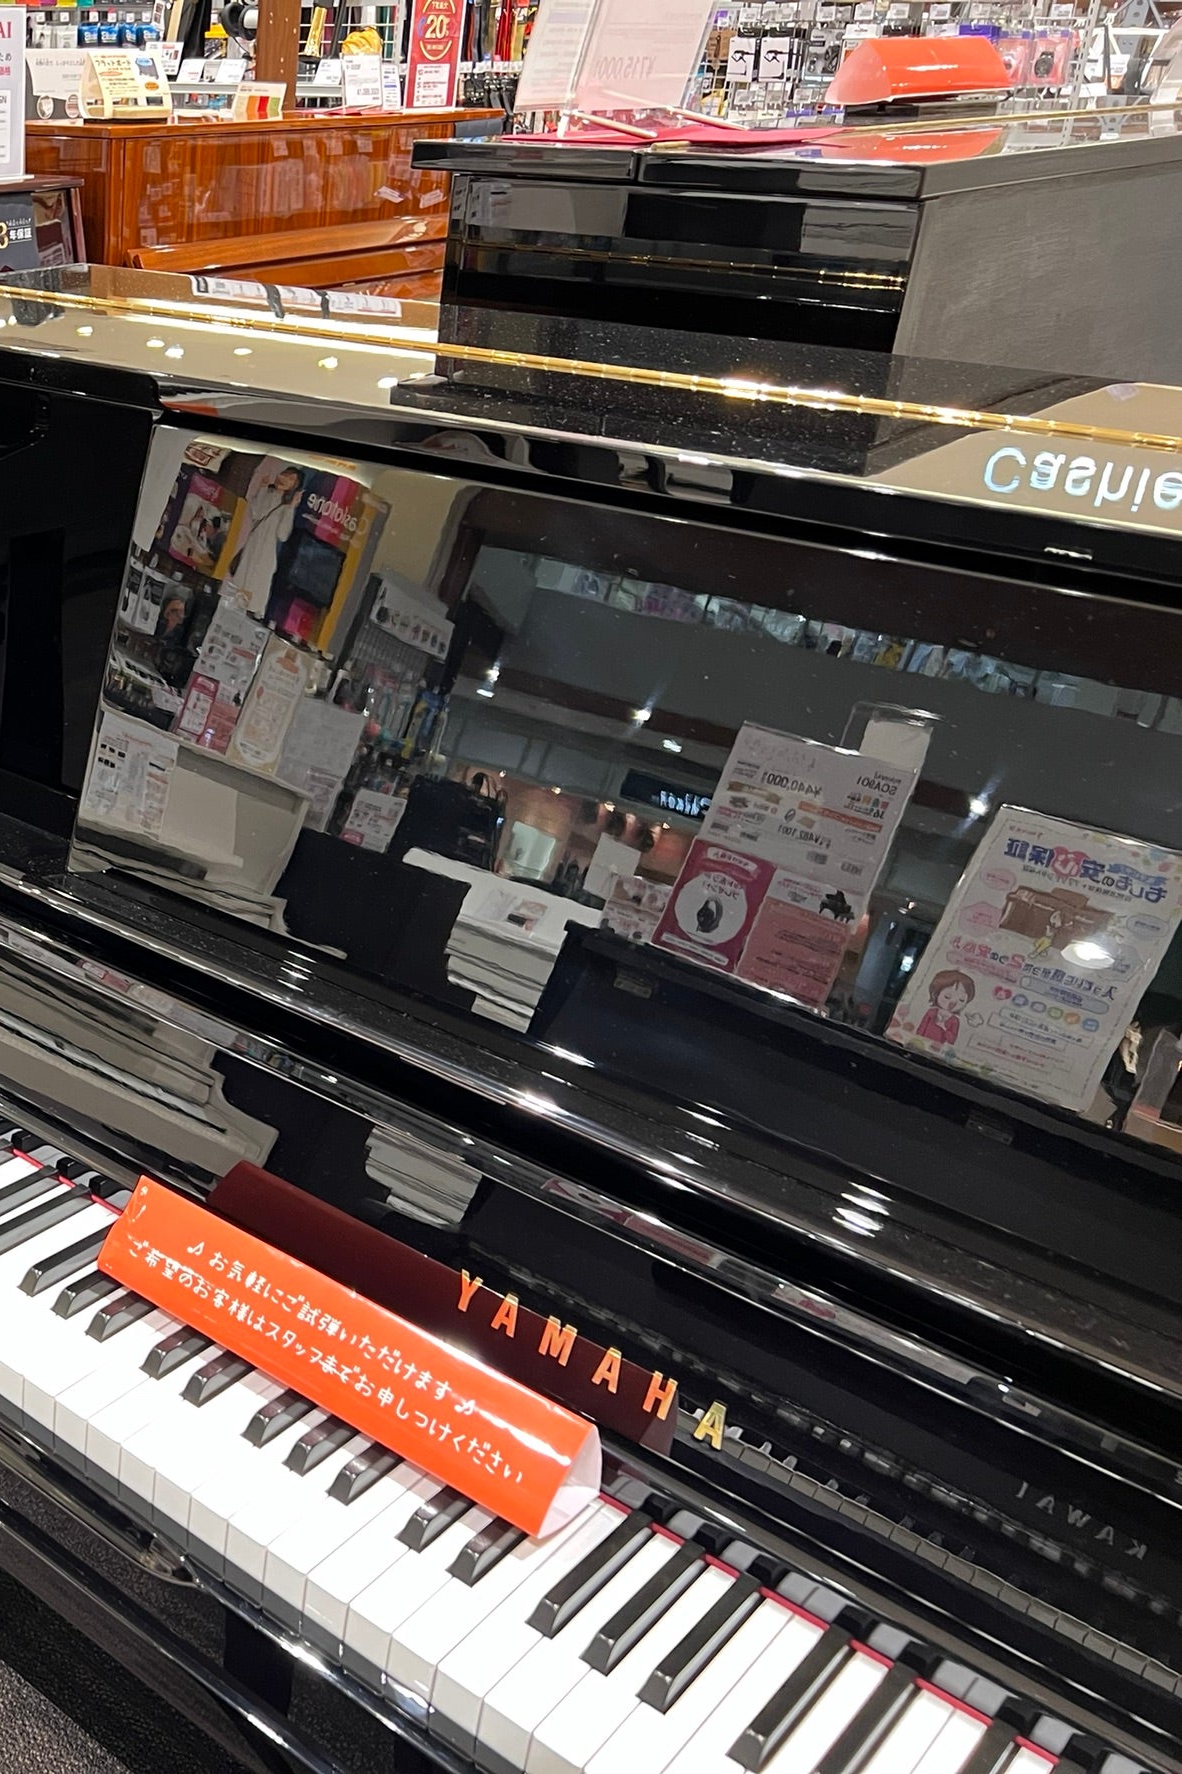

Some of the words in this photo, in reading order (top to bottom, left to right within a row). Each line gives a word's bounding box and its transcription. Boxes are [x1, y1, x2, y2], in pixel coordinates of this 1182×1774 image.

[209, 1251, 452, 1400] お気軽にご試弾いただけます
[456, 1269, 730, 1452] YAMAHA
